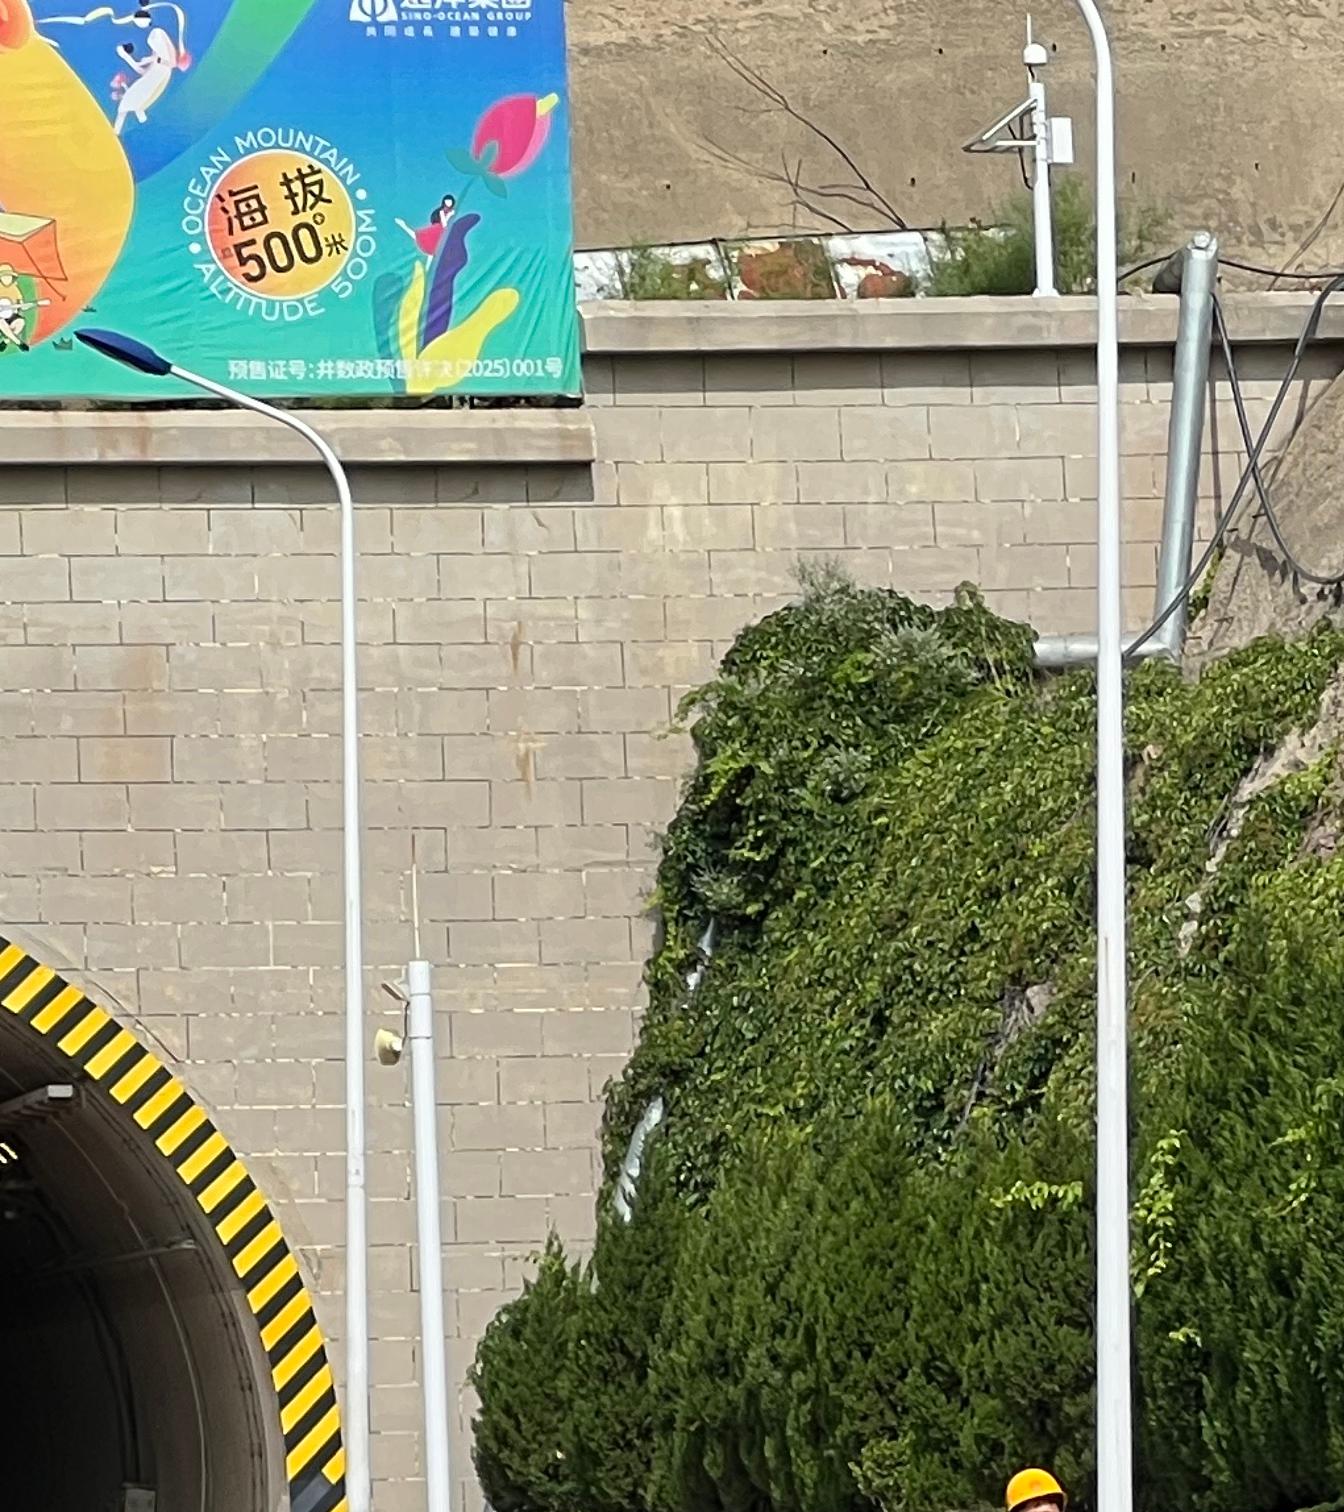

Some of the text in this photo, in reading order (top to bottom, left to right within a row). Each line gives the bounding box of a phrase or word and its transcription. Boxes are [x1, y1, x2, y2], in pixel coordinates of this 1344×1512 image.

[400, 12, 532, 21] SINO-OCEAN GROUP
[181, 127, 361, 236] OCEAN MOUNTAIN
[215, 164, 333, 237] 海拔
[193, 208, 377, 322] ALTITUDE 500M
